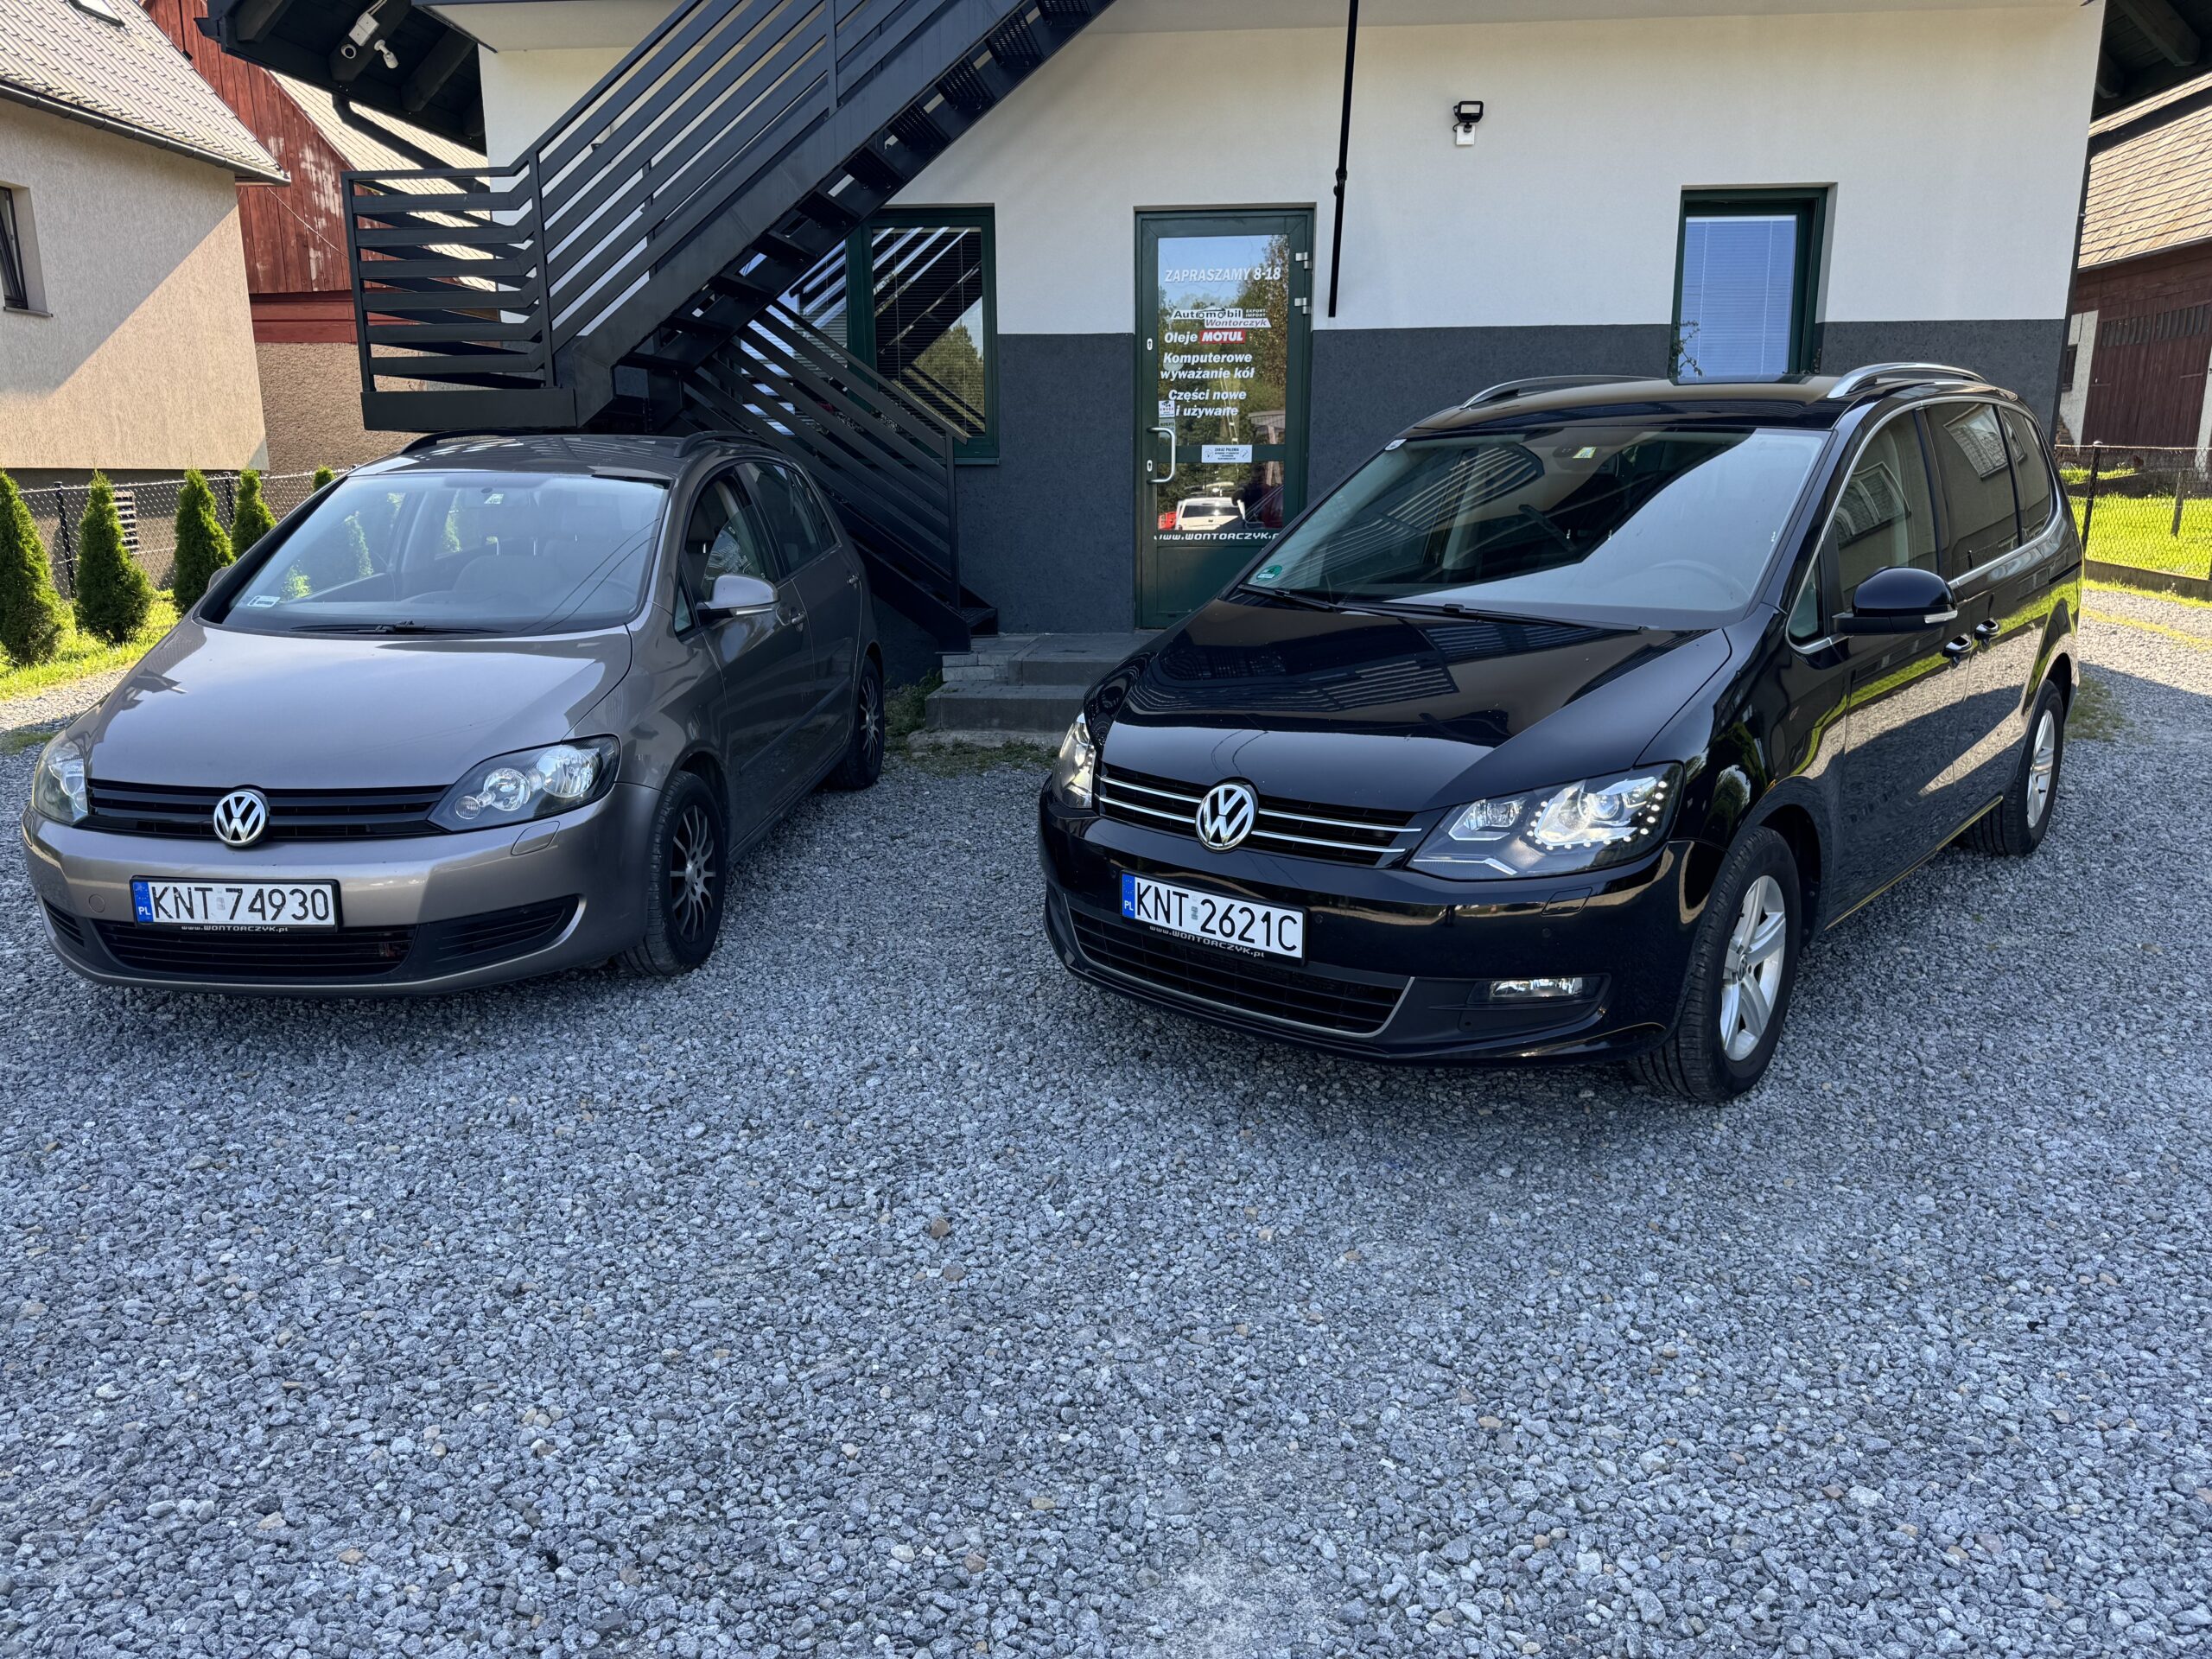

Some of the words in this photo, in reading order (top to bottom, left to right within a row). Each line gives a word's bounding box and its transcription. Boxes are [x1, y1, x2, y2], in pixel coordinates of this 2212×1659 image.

[1165, 268, 1251, 282] ZAPRASZAMY
[1253, 267, 1281, 281] 8-18
[1174, 309, 1241, 319] Automobil
[1164, 331, 1198, 345] Oleje
[1202, 331, 1243, 342] MOTUL
[1163, 353, 1253, 365] Komputerowe
[1160, 367, 1230, 381] wyważanie
[1234, 366, 1255, 378] kół
[1168, 388, 1210, 402] Części
[1212, 391, 1247, 400] nowe
[1175, 405, 1180, 416] i
[1183, 404, 1239, 418] używane
[138, 906, 150, 915] PL
[151, 886, 213, 919] KNT
[226, 887, 330, 921] 74930
[1124, 900, 1134, 911] PL
[1137, 882, 1189, 926] KNT
[1200, 899, 1298, 951] 2621C
